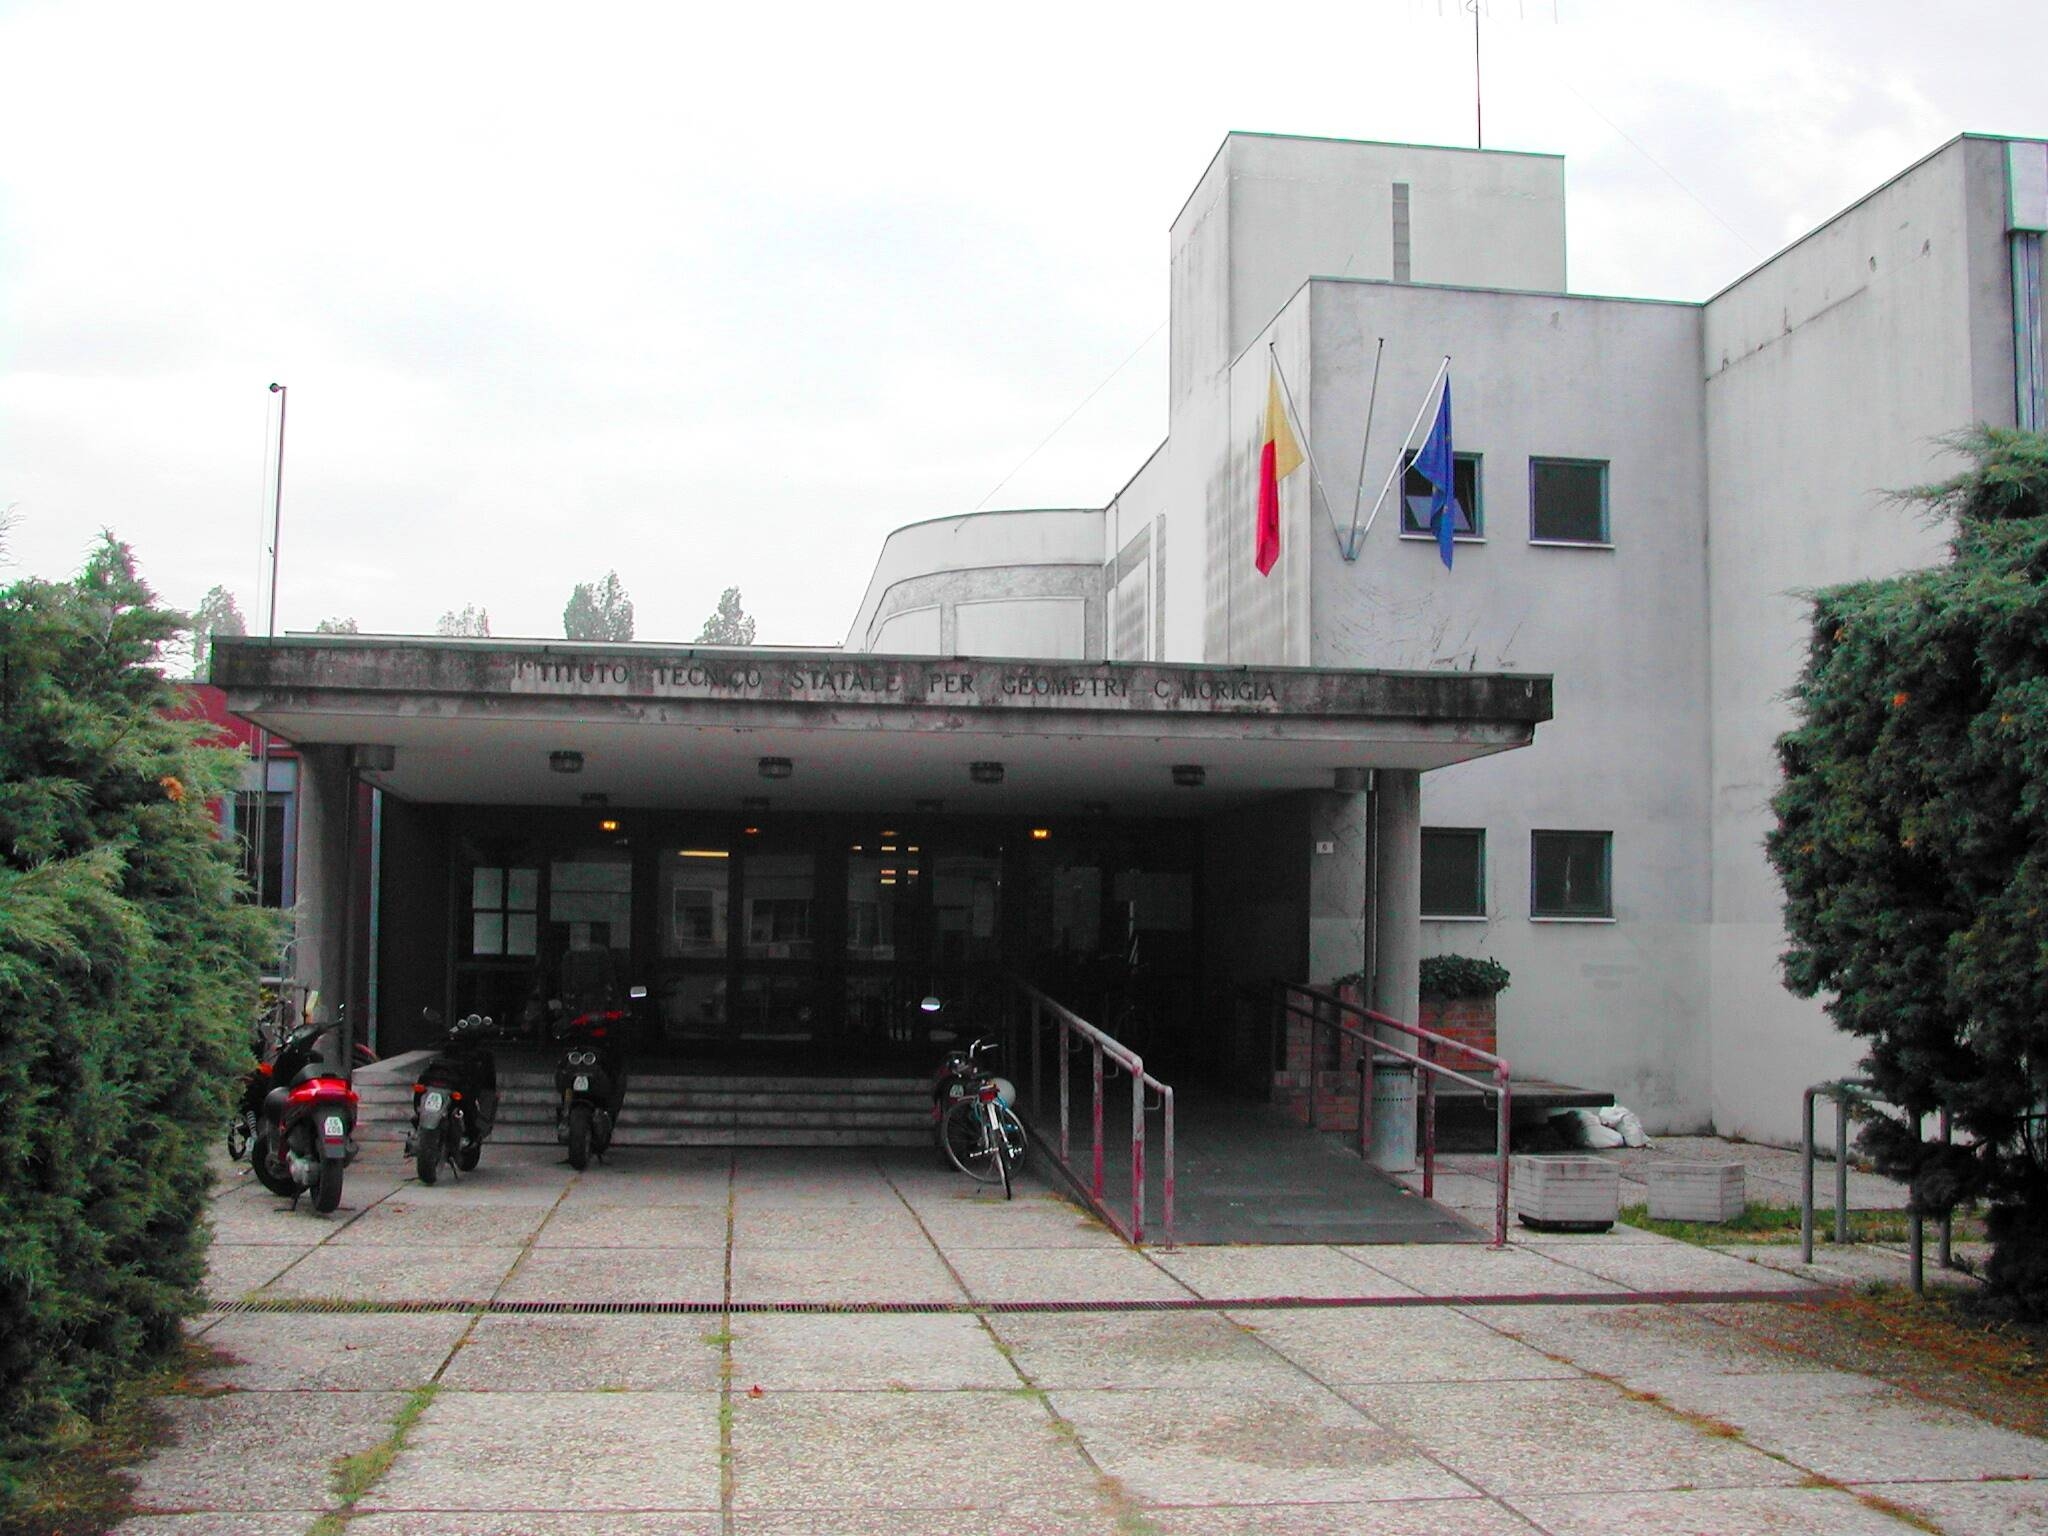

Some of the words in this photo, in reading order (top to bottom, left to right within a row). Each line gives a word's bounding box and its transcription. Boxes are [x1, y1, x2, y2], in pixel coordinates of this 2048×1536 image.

[517, 662, 628, 684] ITITUTO
[656, 665, 762, 688] TECNICO
[791, 669, 900, 692] STATALE
[928, 673, 975, 693] PER
[1002, 676, 1128, 698] GEOMETRI
[1181, 680, 1277, 701] MORIGIA
